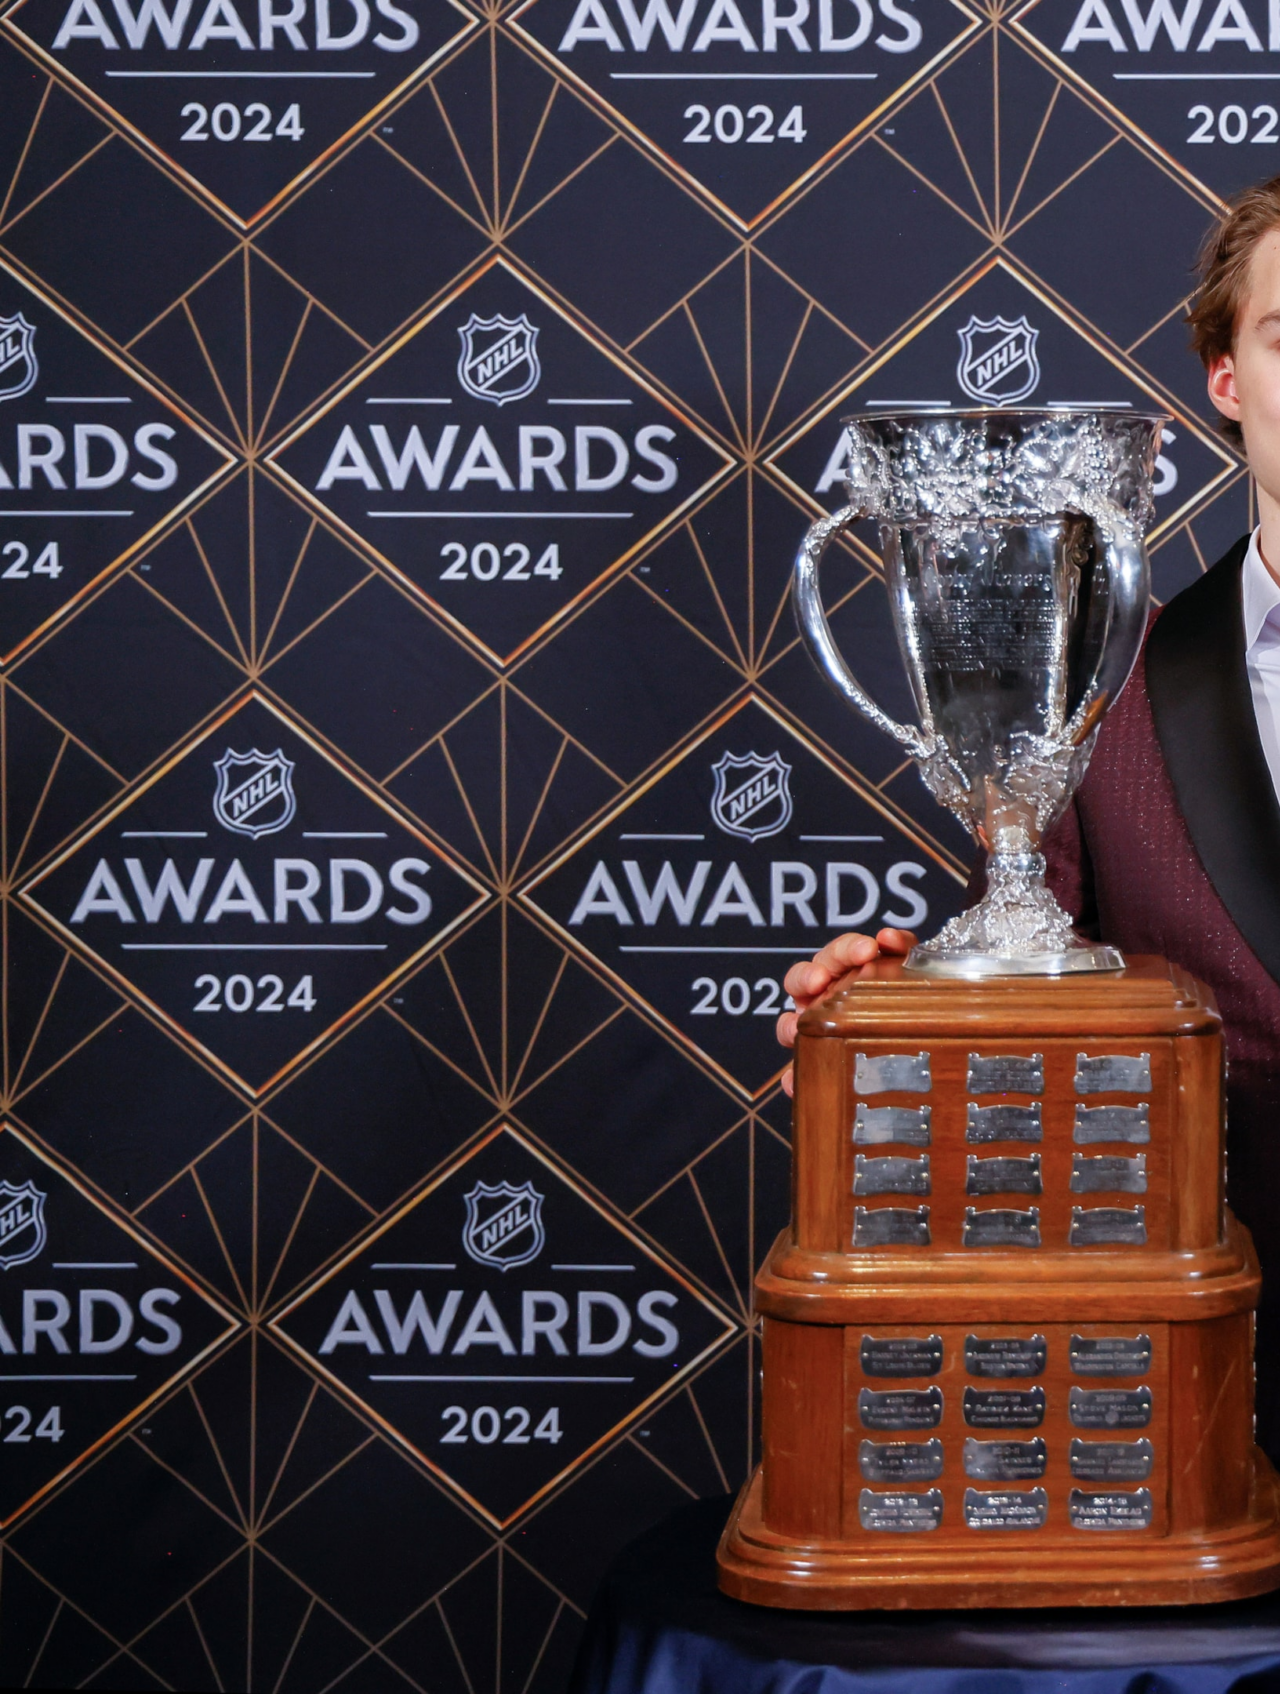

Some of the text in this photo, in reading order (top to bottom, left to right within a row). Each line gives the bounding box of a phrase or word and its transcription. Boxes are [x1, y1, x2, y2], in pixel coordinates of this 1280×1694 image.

[53, 0, 421, 53] AWARDS
[558, 0, 924, 55] AWARDS
[181, 103, 306, 142] 2024
[684, 105, 808, 145] 2024
[476, 338, 524, 384] NHL
[976, 340, 1024, 388] NHL
[0, 423, 179, 492] RDS
[316, 425, 679, 494] AWARDS
[440, 543, 564, 582] 2024
[232, 771, 279, 818] NHL
[729, 774, 777, 822] NHL
[71, 859, 433, 926] AWARDS
[569, 861, 928, 929] AWARDS
[194, 975, 317, 1013] 2024
[481, 1204, 528, 1251] NHL
[320, 1291, 679, 1358] AWARDS
[0, 1406, 64, 1443] 24
[441, 1407, 563, 1444] 2024
